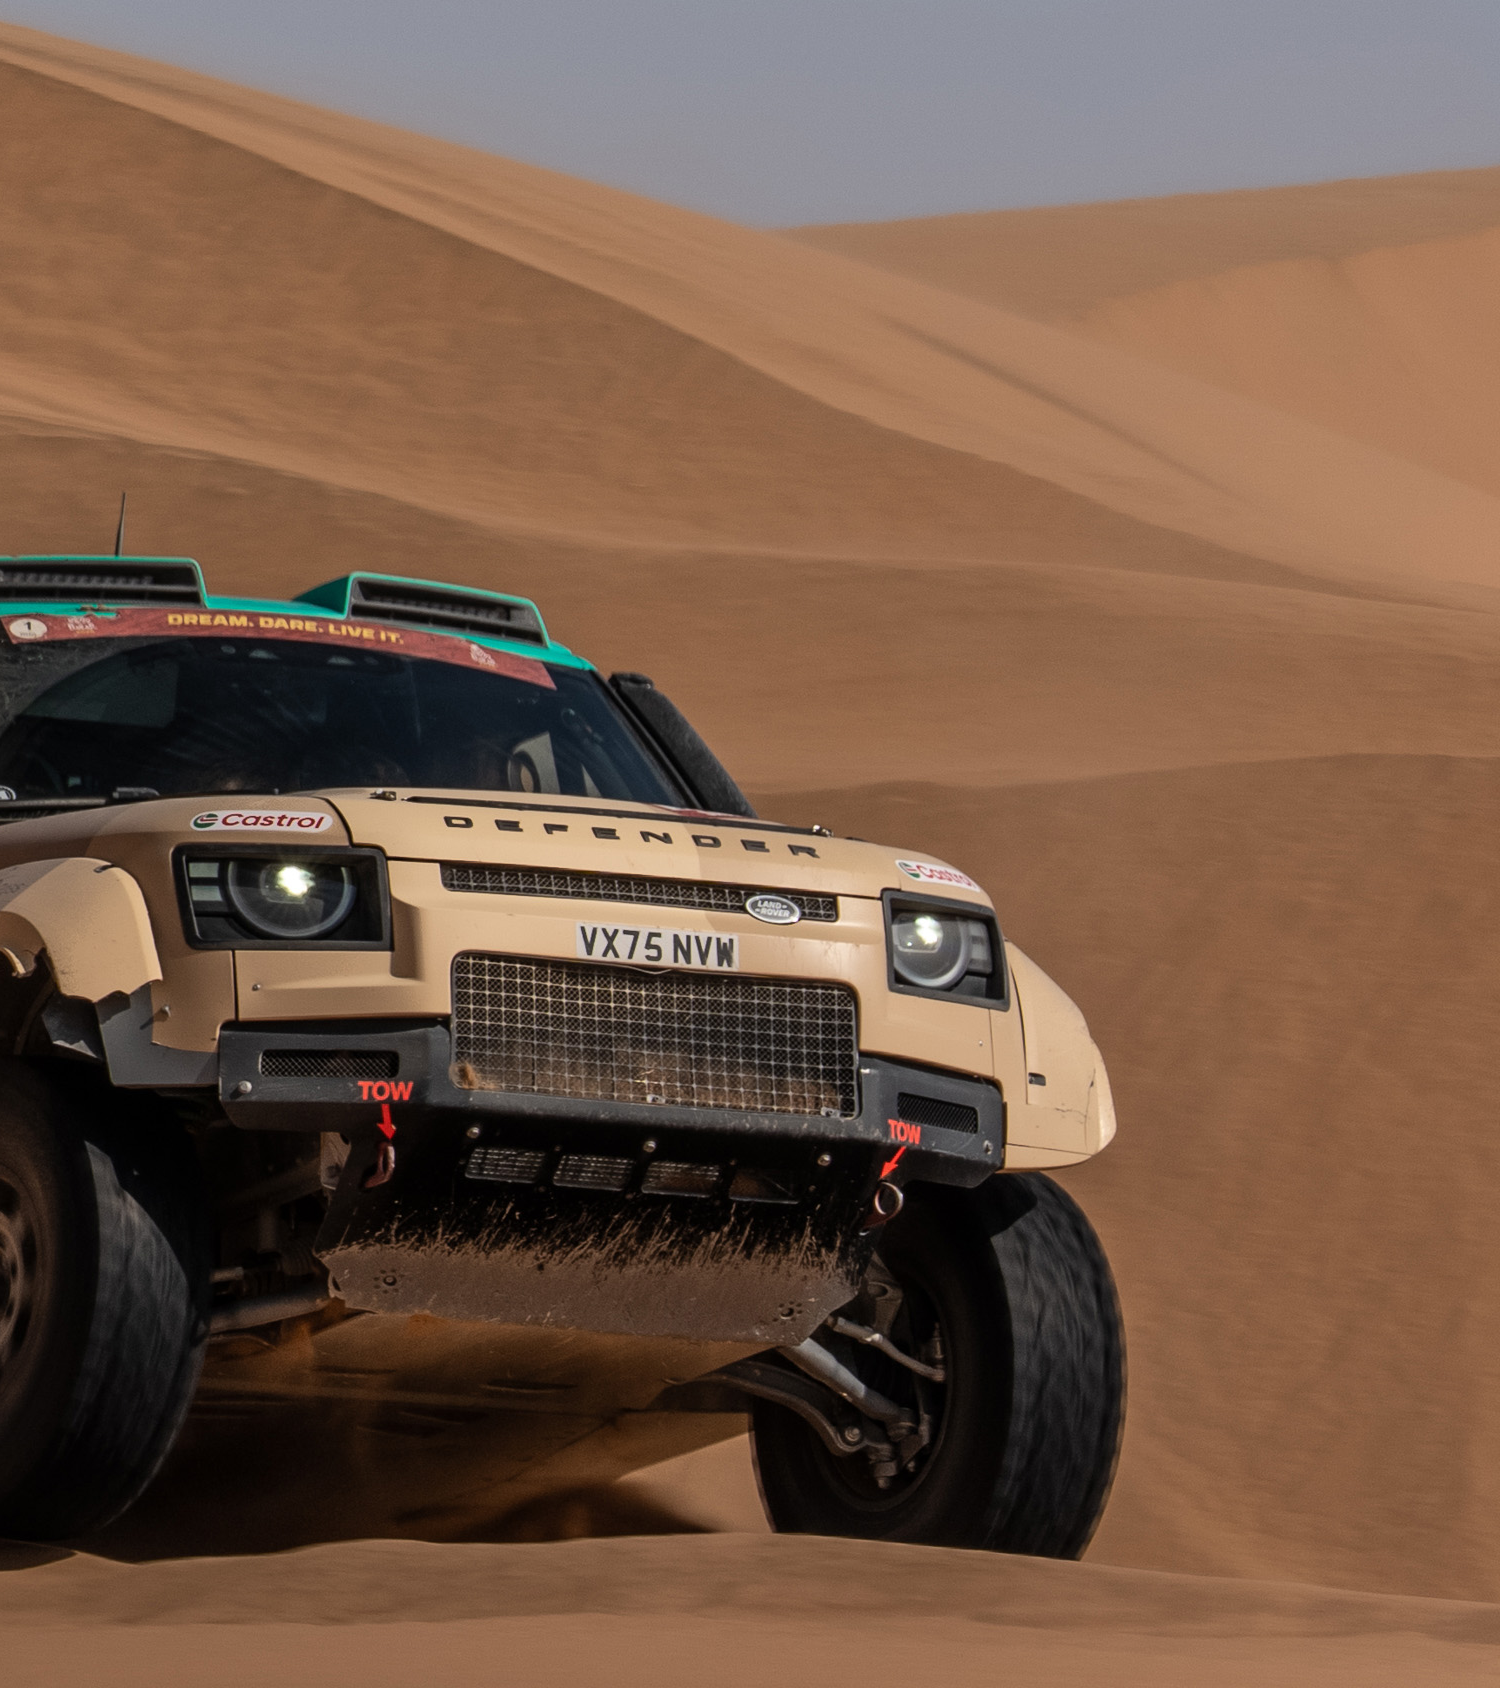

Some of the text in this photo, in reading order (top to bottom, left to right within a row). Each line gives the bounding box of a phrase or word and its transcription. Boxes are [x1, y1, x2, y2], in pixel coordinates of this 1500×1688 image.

[167, 612, 404, 645] DREAM. DARE. LIVE IT.
[221, 812, 325, 830] Castrol
[443, 815, 821, 859] DEFENDER
[757, 900, 782, 909] LAND
[760, 908, 790, 917] ROVER
[580, 925, 734, 968] VX75 NVW
[357, 1080, 414, 1101] TOW
[887, 1118, 921, 1145] TOW
